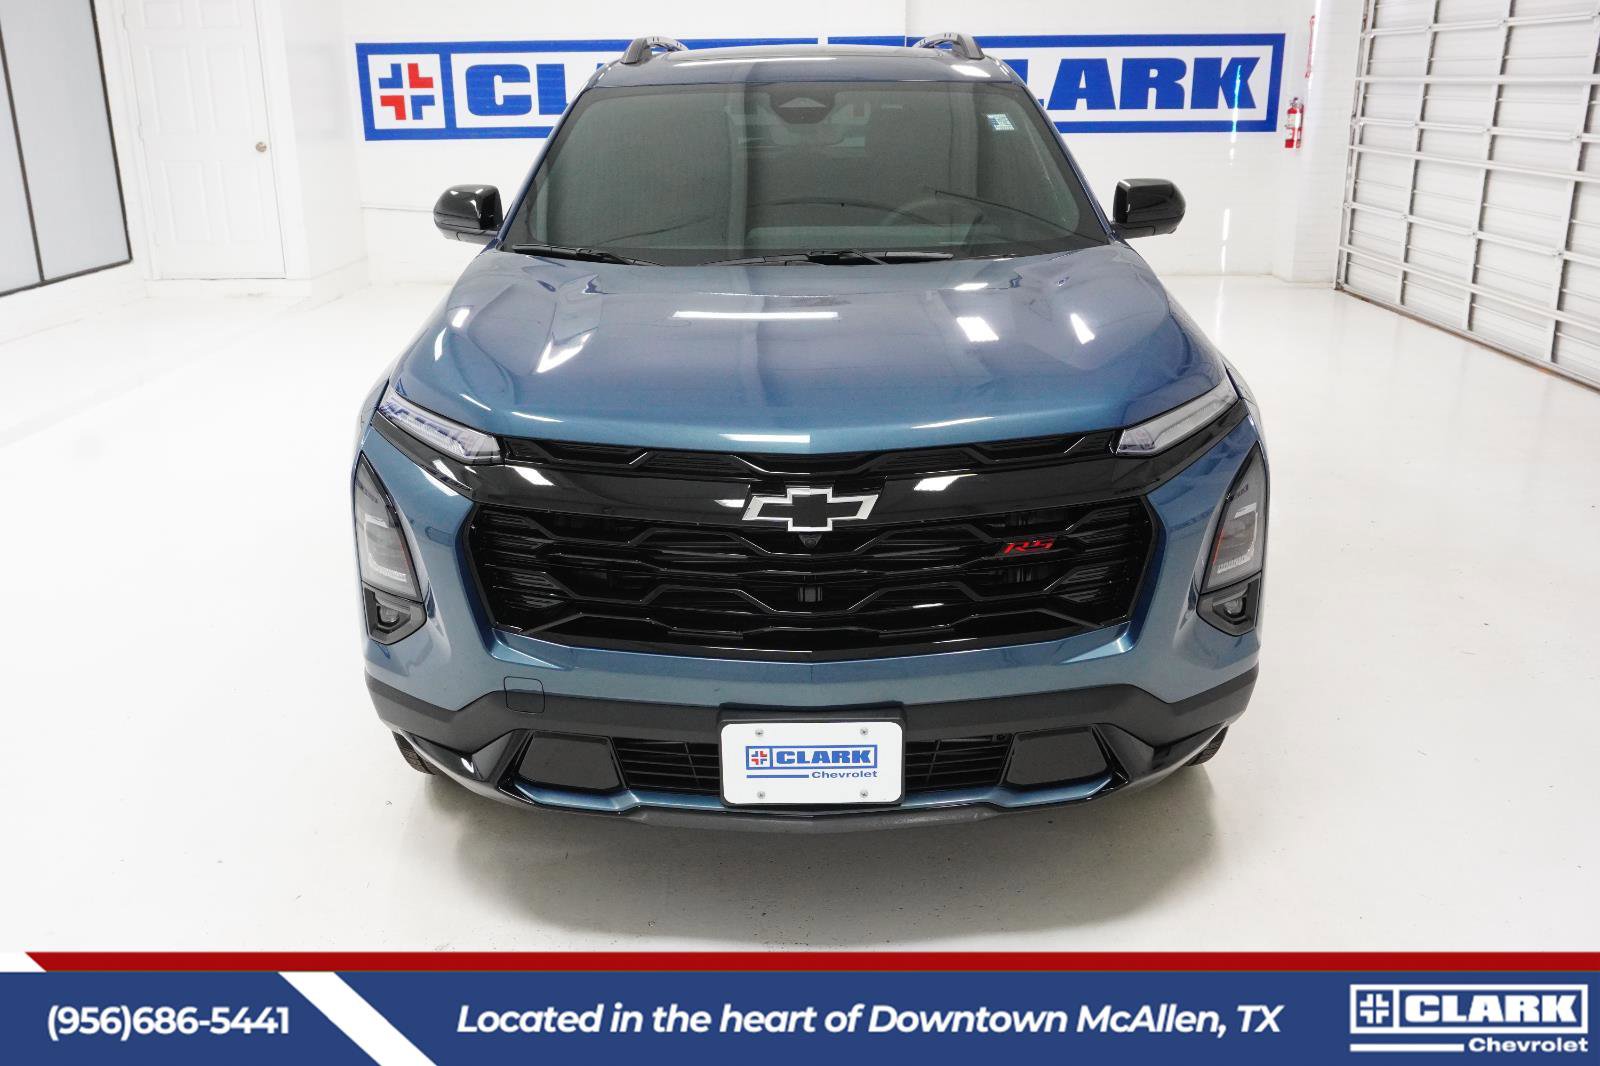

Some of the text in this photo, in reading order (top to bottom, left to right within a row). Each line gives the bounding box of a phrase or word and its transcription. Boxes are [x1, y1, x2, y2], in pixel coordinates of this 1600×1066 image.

[1000, 538, 1054, 555] RS
[776, 750, 871, 765] CLARK
[811, 770, 877, 779] Chevrolet
